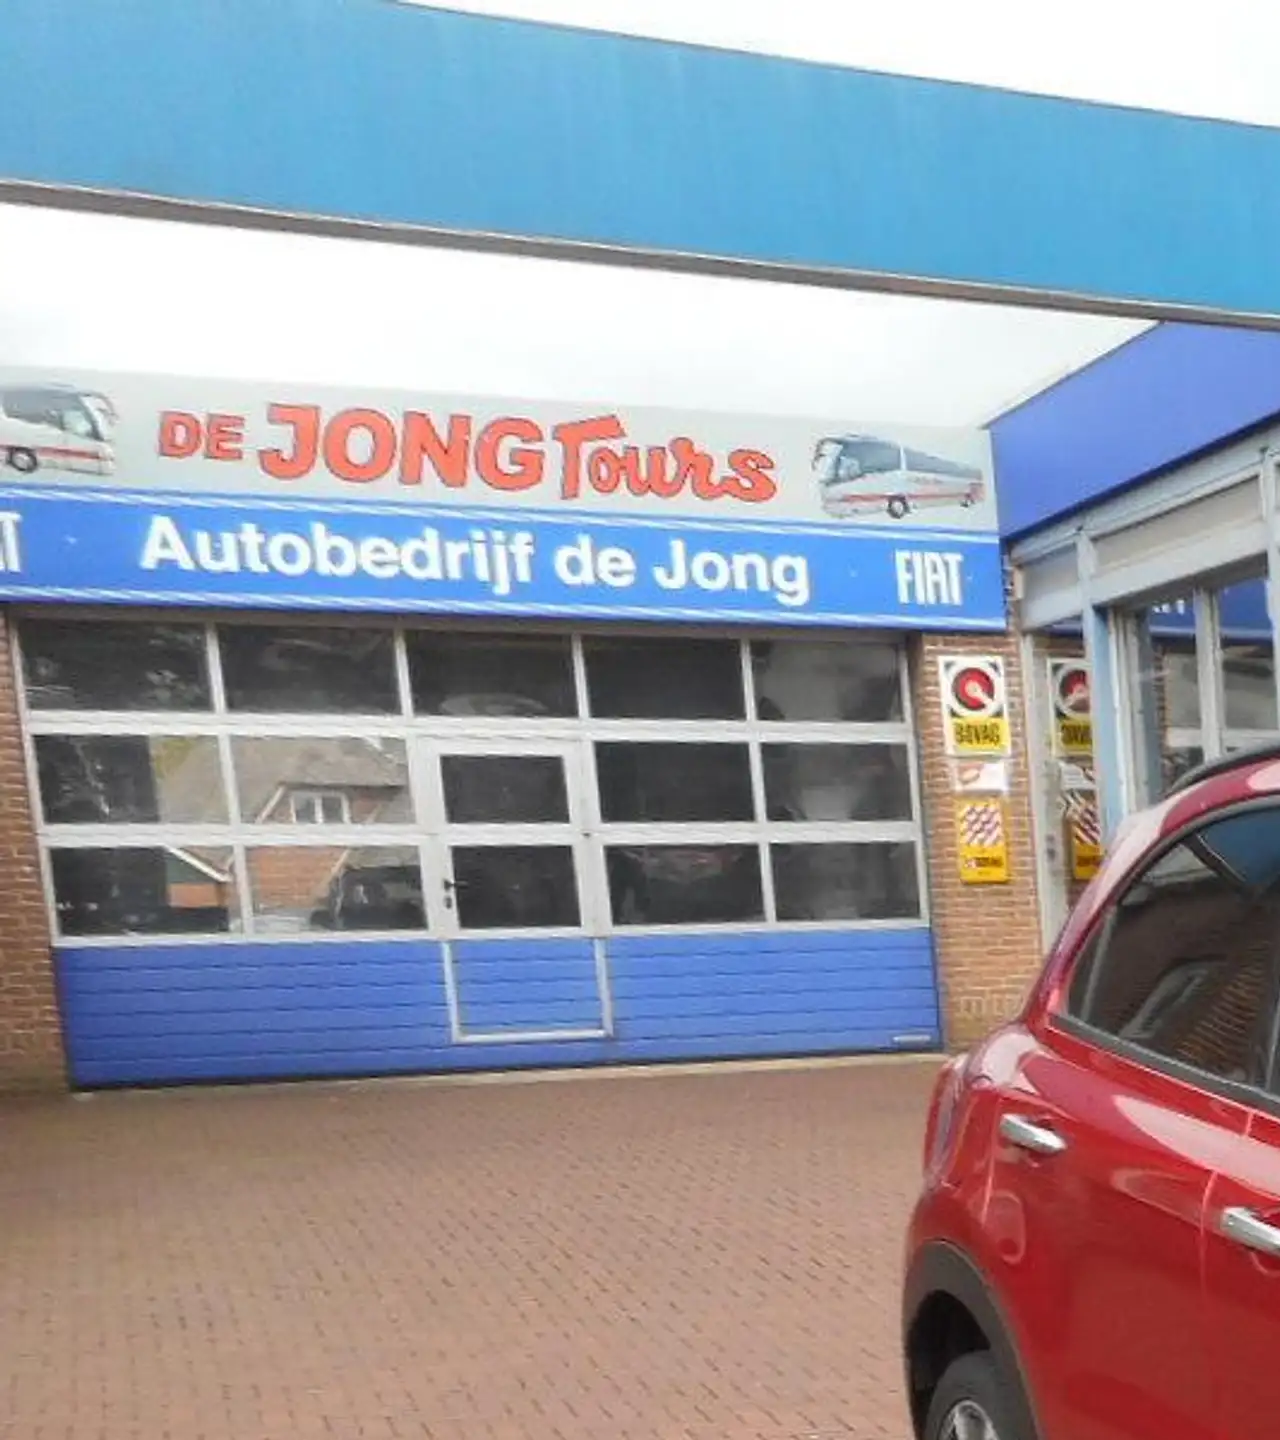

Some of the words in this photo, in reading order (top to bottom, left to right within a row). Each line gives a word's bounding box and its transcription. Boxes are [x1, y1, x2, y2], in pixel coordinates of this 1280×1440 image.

[158, 410, 245, 461] DE
[259, 402, 545, 492] JONG
[552, 413, 778, 502] Tours
[0, 510, 23, 573] T
[140, 514, 535, 596] Autobedrijf
[553, 534, 635, 588] de
[653, 539, 810, 607] Jong
[894, 549, 964, 606] FIAT
